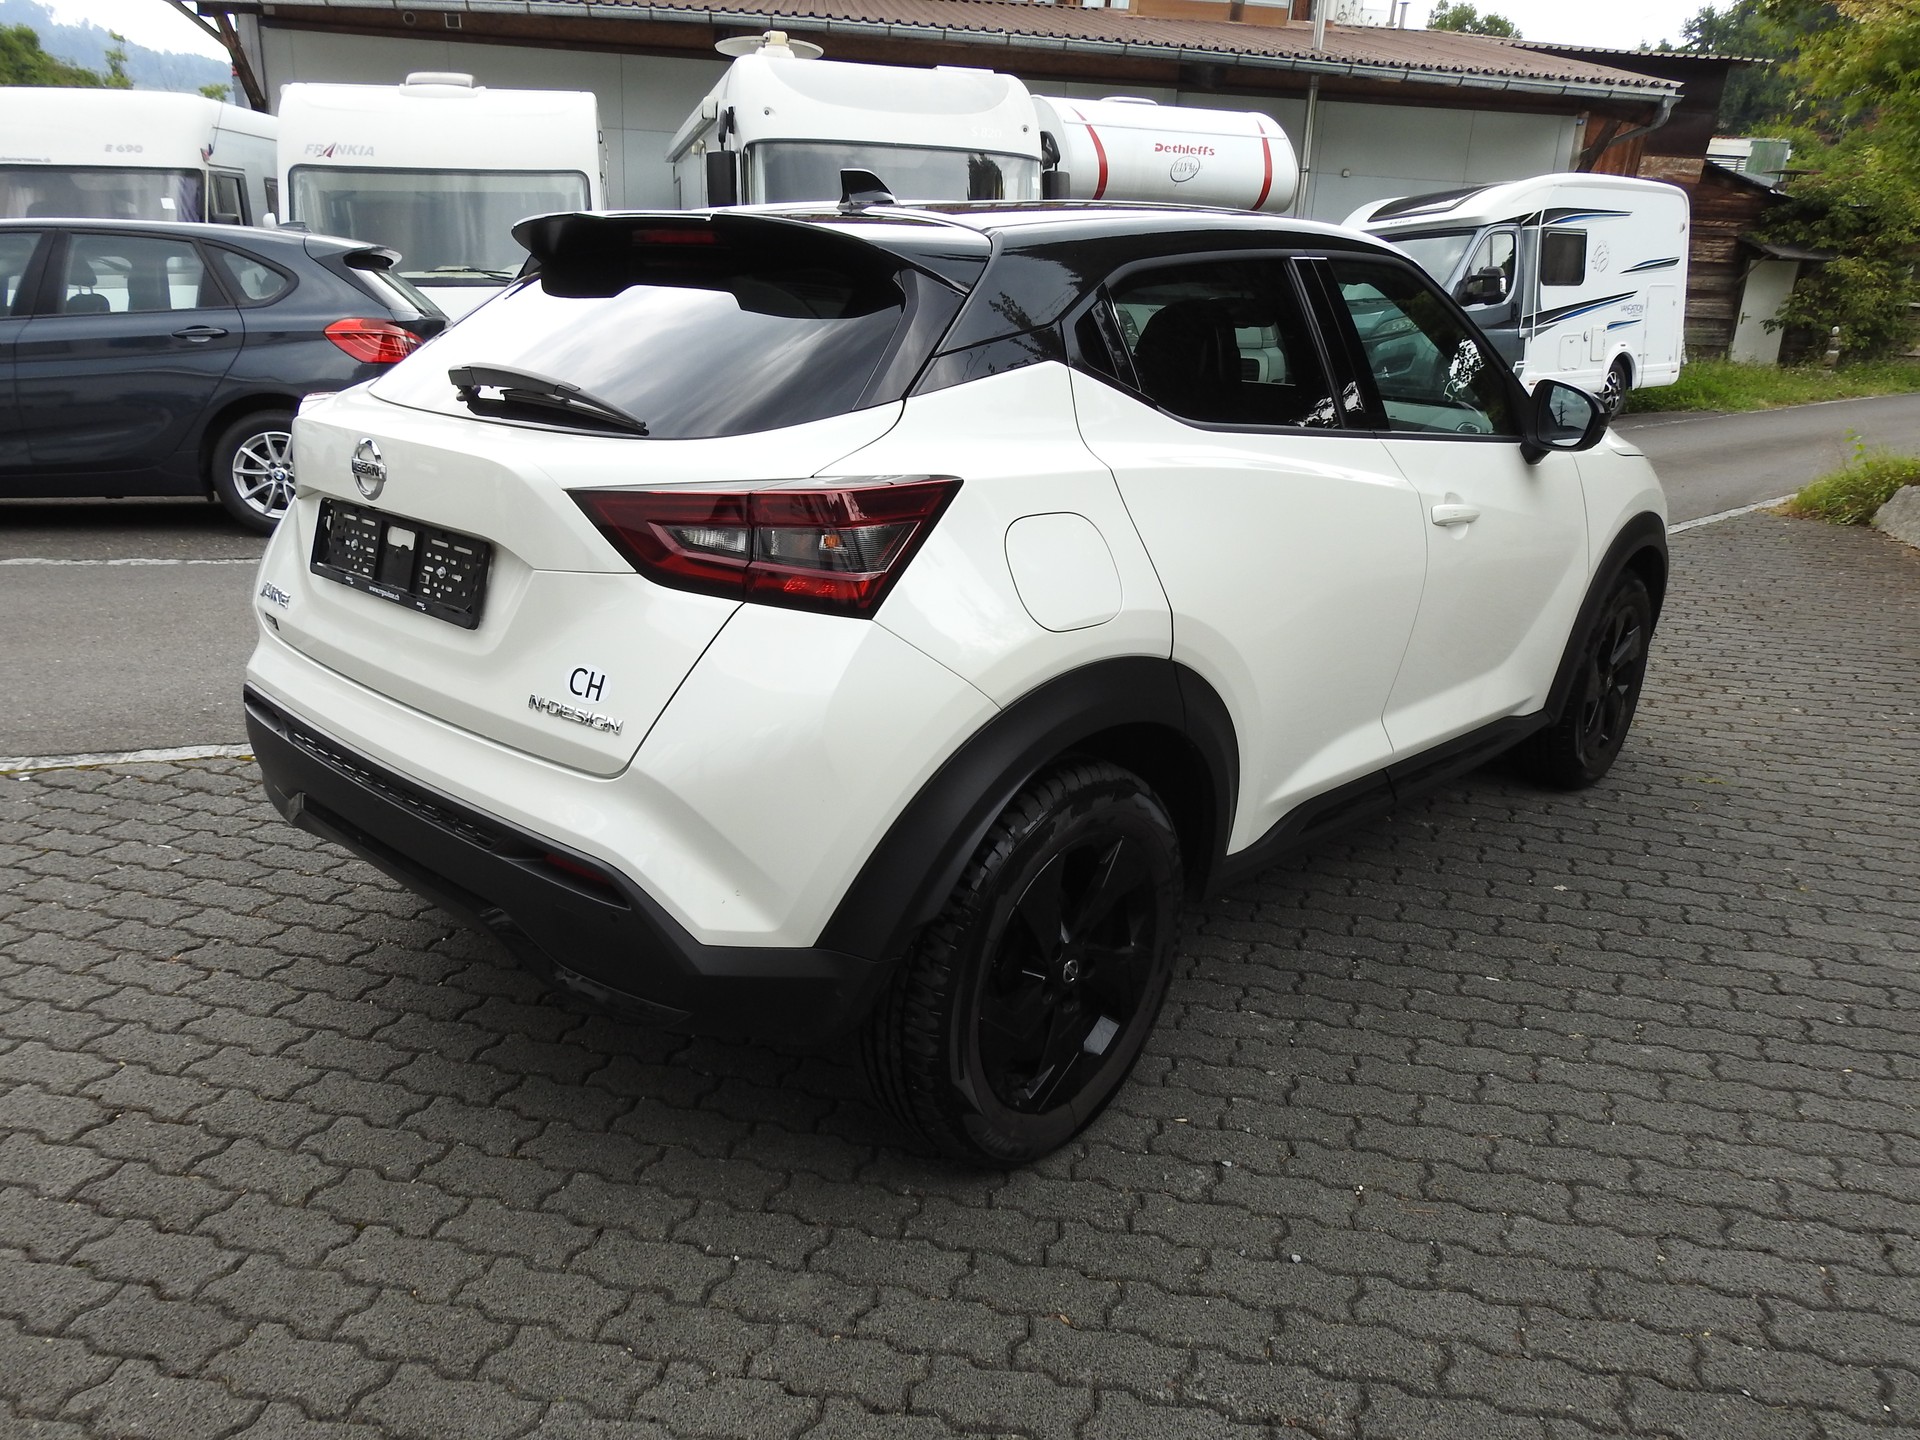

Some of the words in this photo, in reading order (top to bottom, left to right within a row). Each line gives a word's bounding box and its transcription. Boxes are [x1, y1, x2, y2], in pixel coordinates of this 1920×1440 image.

[104, 144, 113, 153] E
[116, 144, 144, 153] 690
[304, 142, 376, 158] FRANKIA
[1154, 143, 1215, 156] Dethleffs
[569, 667, 606, 702] CH
[527, 693, 625, 737] N-DESIGN
